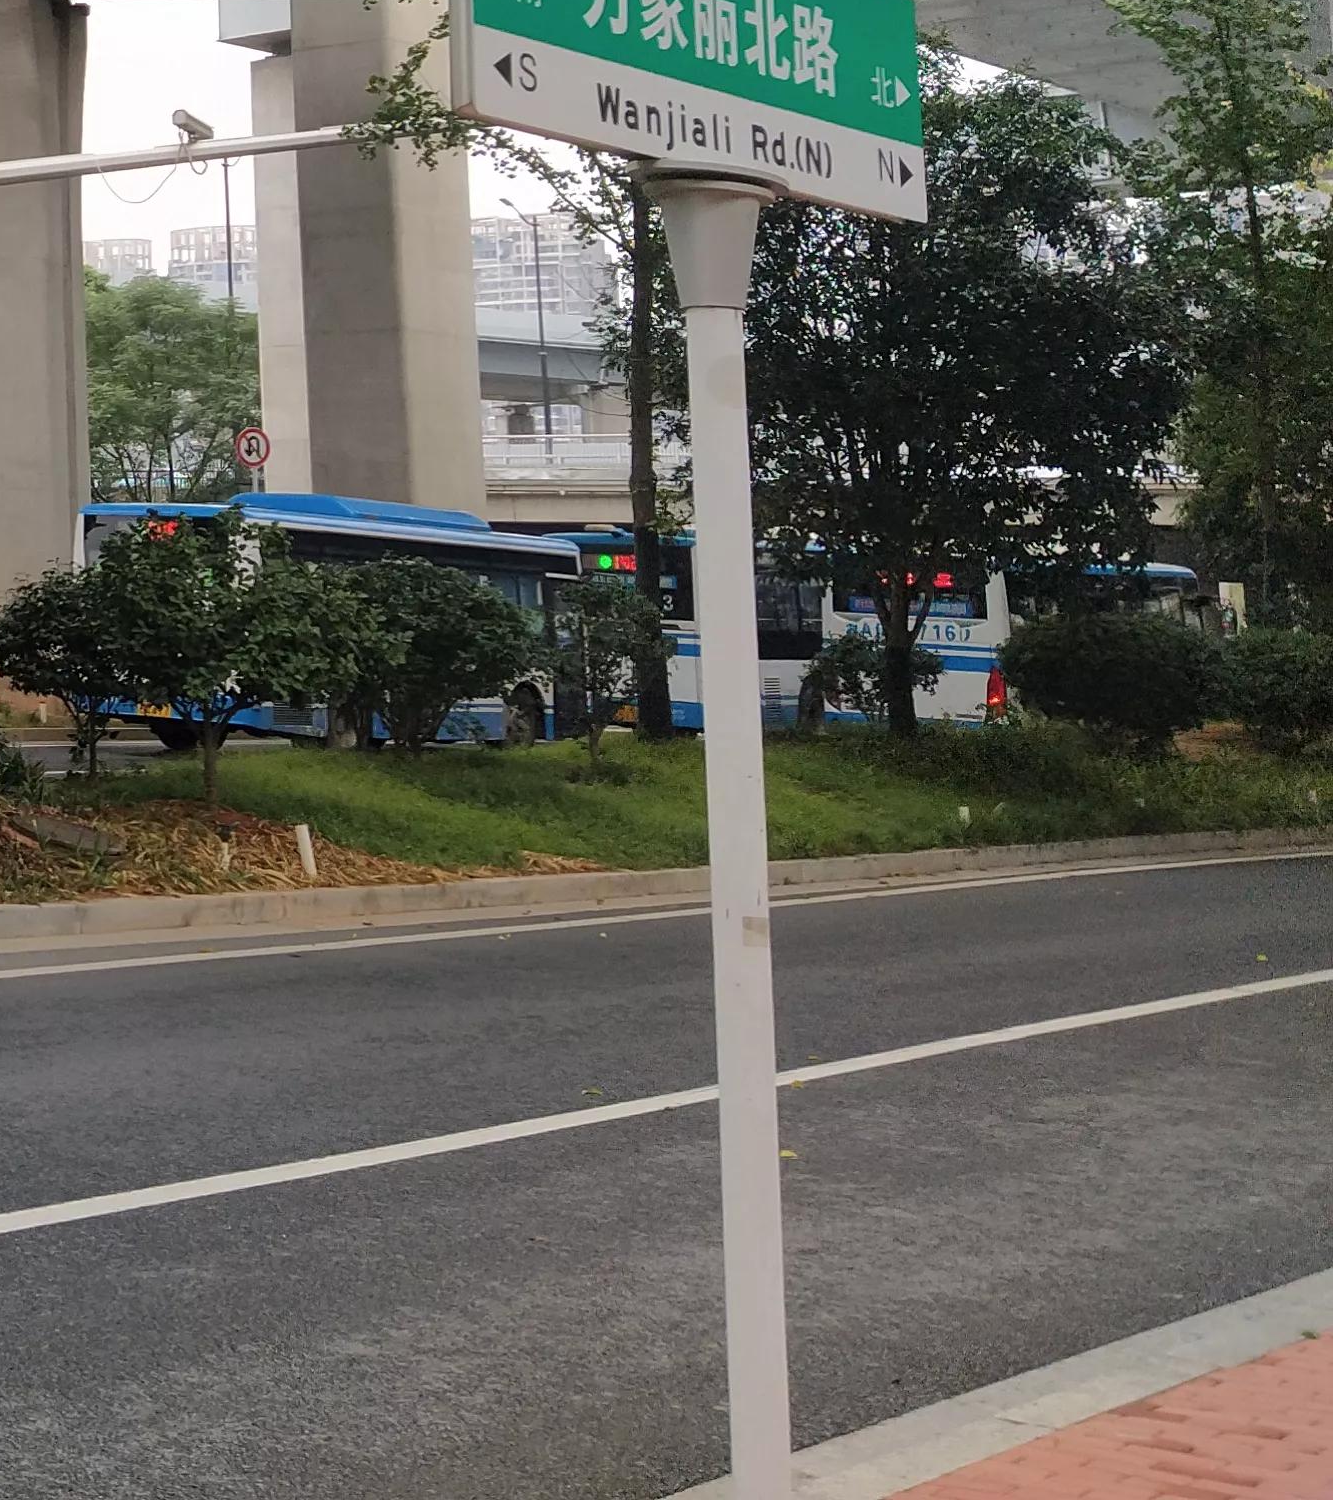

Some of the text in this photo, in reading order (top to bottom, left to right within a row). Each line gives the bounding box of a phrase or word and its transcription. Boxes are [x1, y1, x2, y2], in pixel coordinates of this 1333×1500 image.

[519, 52, 539, 93] S
[870, 66, 896, 109] 北
[596, 81, 833, 180] Wanjiali Rd.(N)
[877, 148, 894, 182] N
